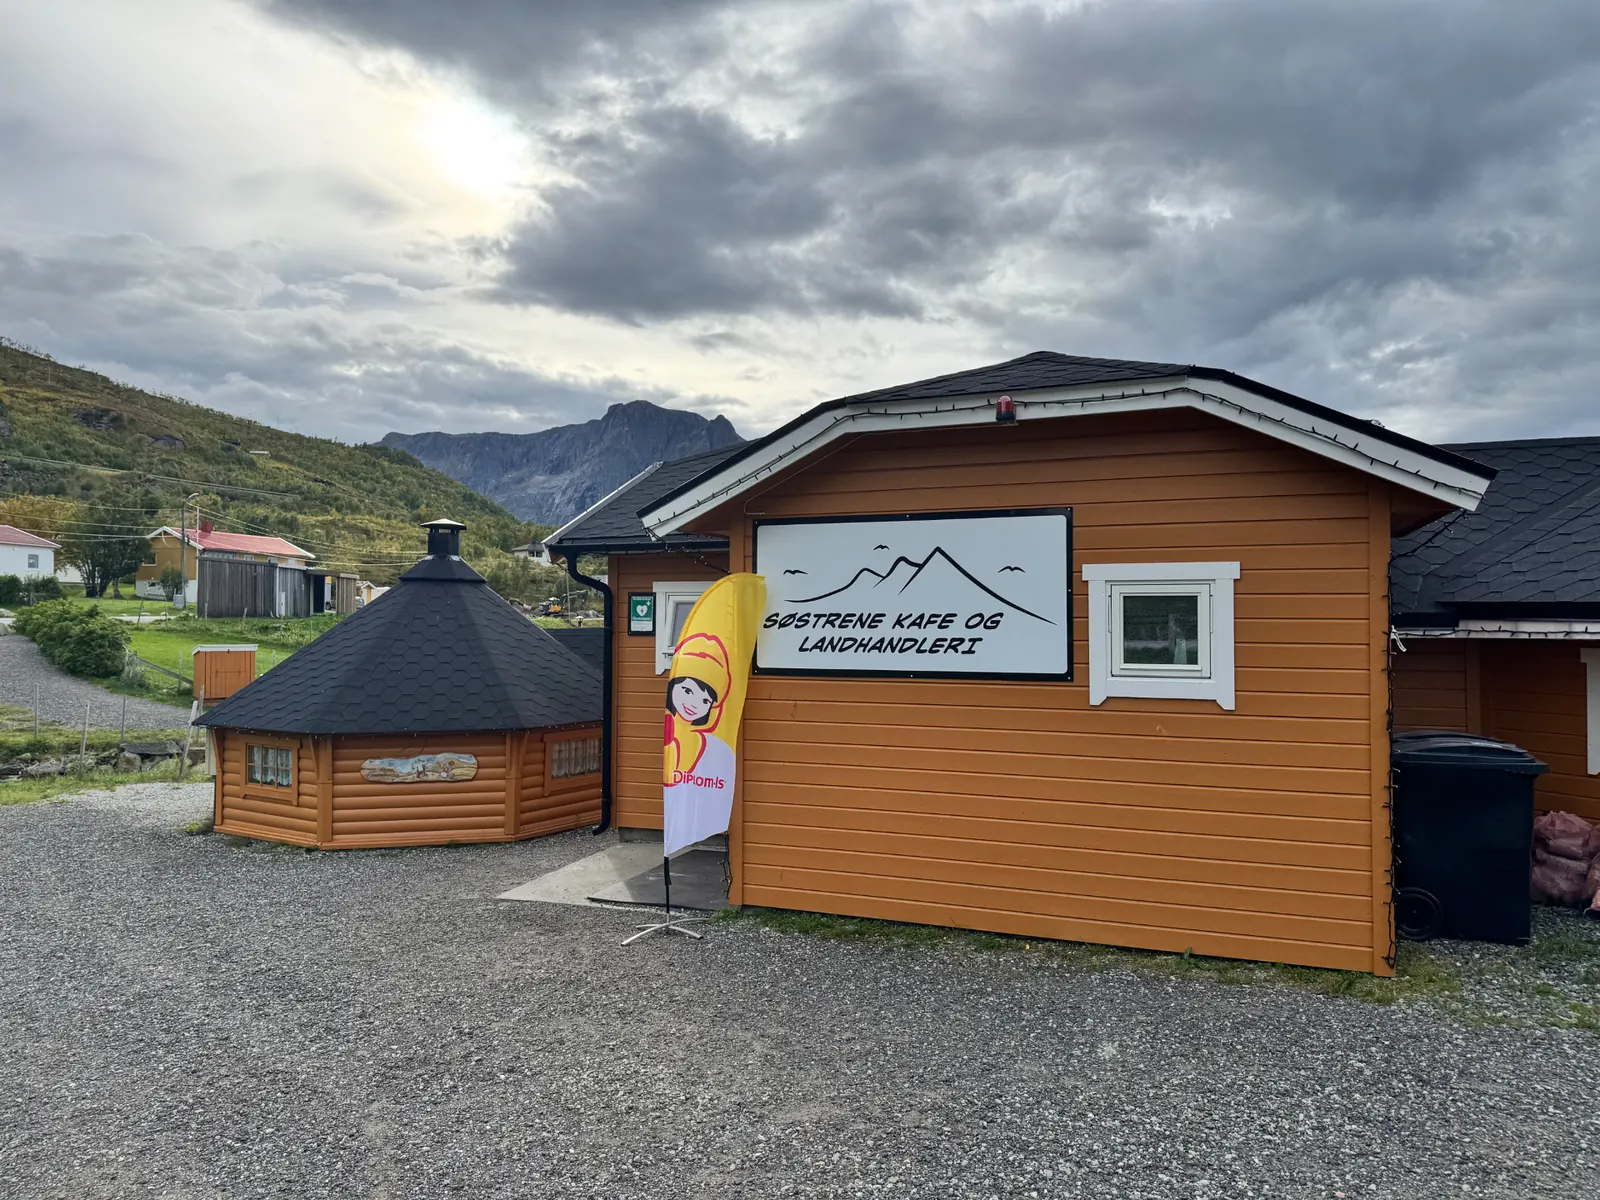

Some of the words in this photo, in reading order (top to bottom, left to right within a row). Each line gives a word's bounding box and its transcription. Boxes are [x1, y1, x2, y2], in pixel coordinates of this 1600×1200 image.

[763, 612, 886, 629] SØSTRENE
[891, 613, 957, 630] KAFE
[964, 612, 1004, 630] OG
[798, 636, 983, 654] LANDHANDLERI
